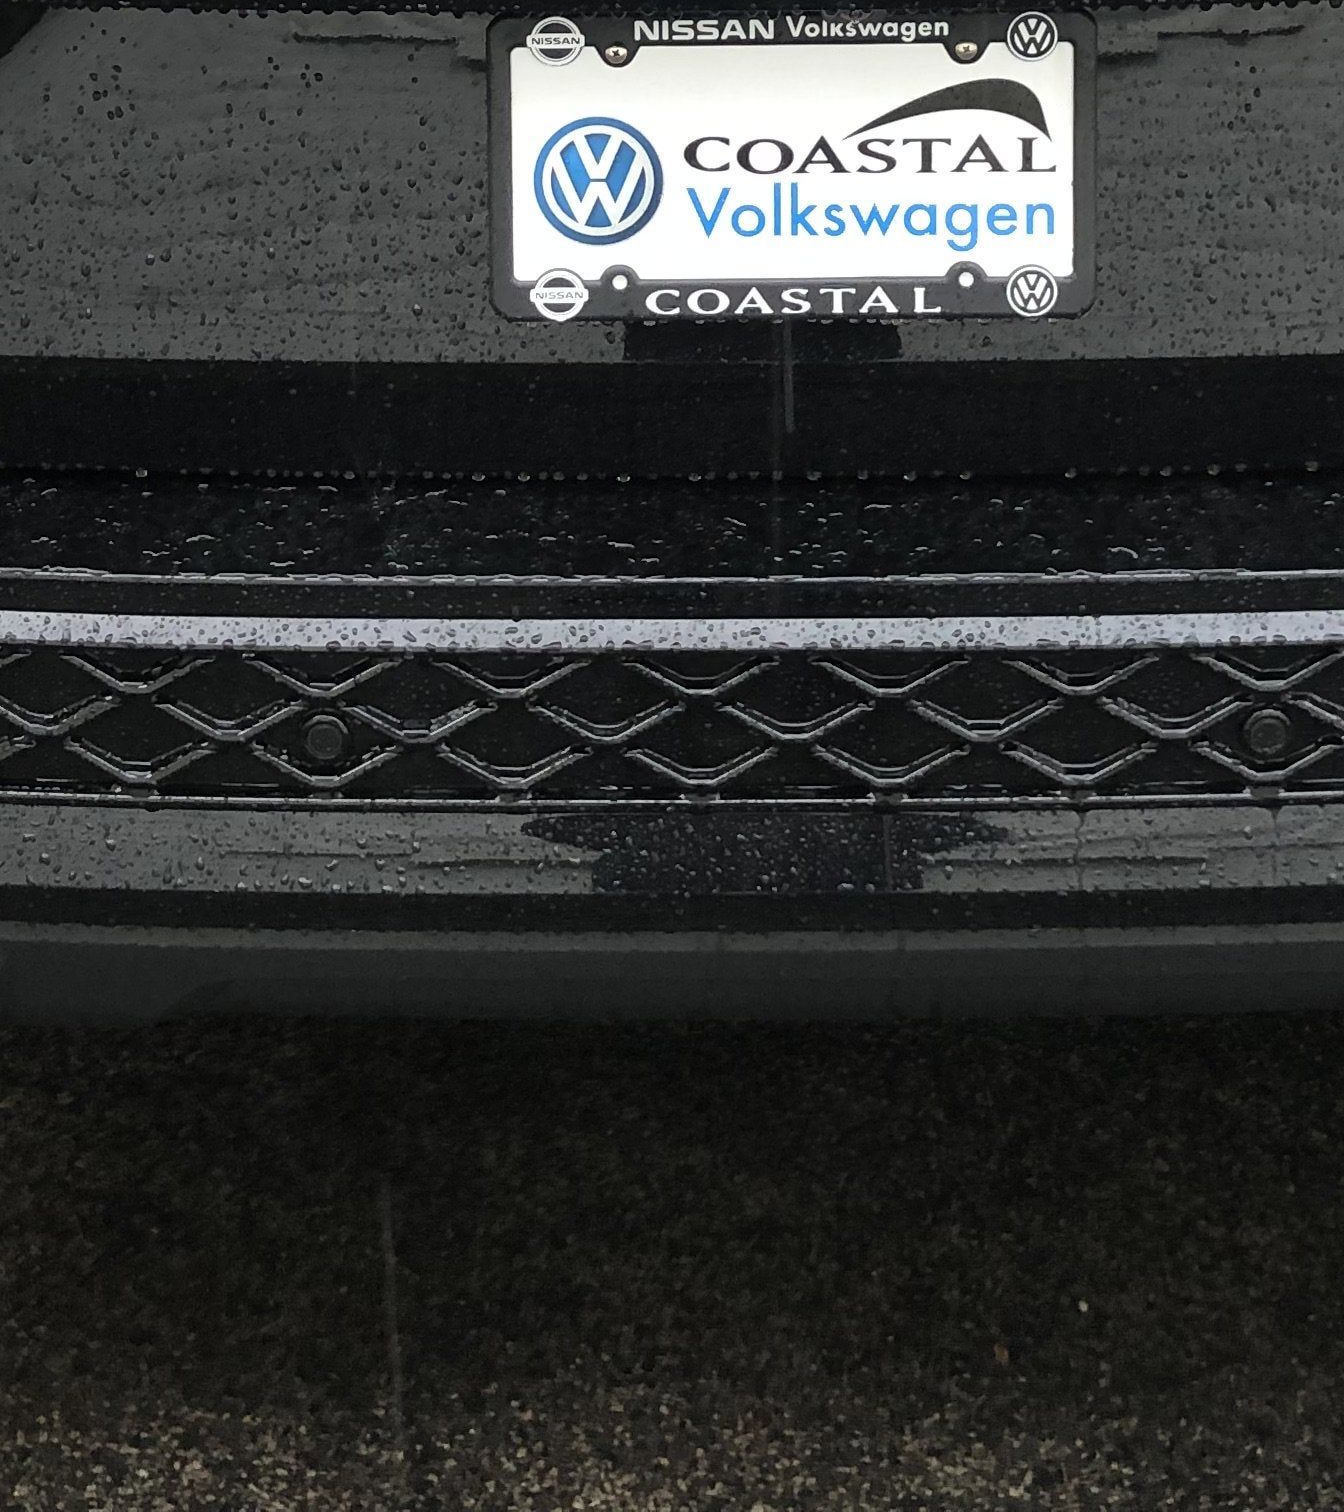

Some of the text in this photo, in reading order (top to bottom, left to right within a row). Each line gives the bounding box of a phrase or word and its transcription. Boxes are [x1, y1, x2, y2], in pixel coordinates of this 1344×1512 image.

[531, 37, 581, 46] NISSAN
[634, 15, 949, 43] NISSAN Volkswagen
[683, 133, 1056, 174] COASTAL
[686, 182, 1055, 251] Volkswagen
[535, 292, 584, 300] NISSAN
[645, 286, 942, 315] COASTAL
